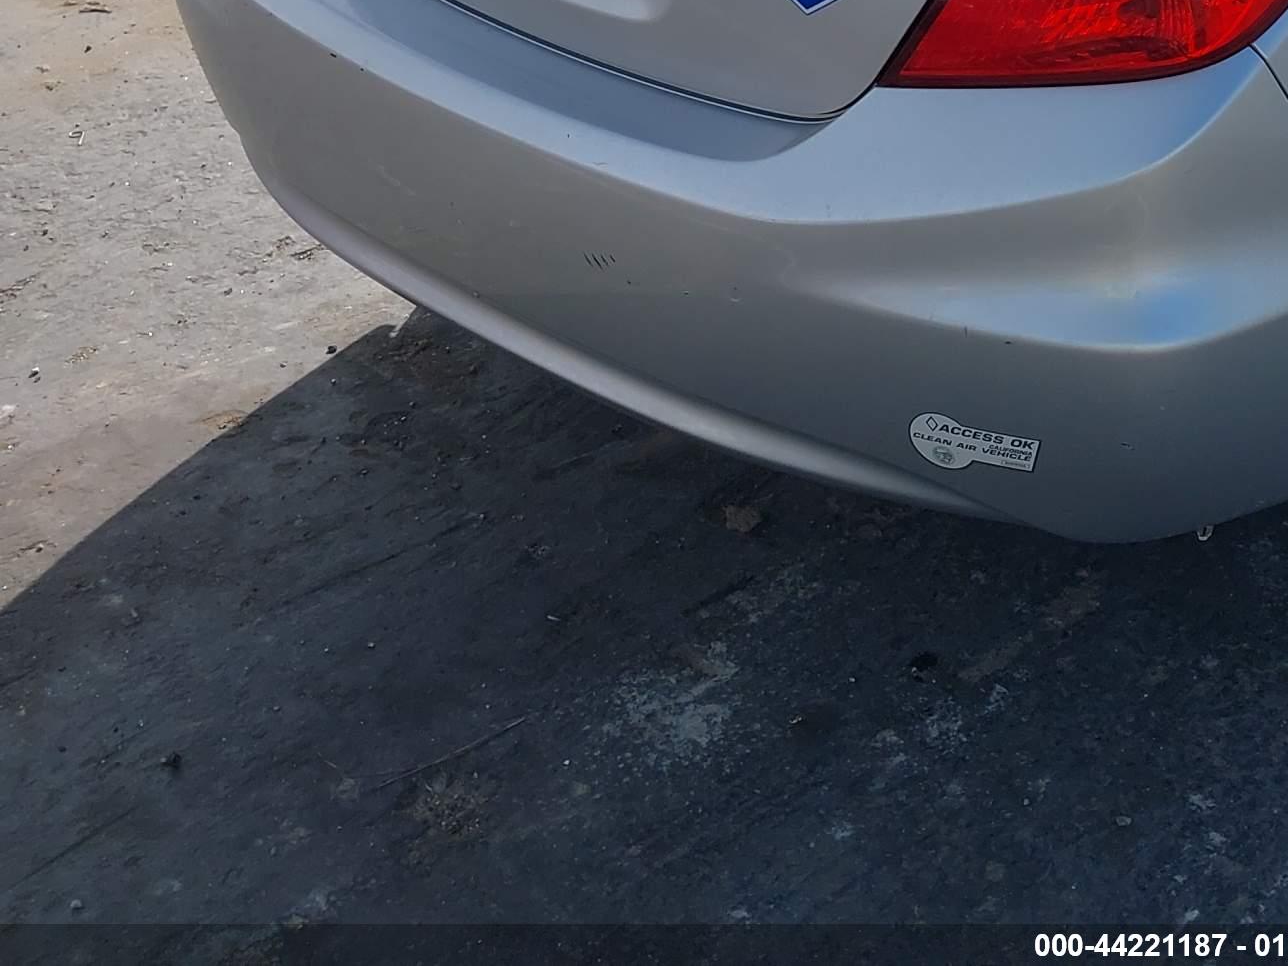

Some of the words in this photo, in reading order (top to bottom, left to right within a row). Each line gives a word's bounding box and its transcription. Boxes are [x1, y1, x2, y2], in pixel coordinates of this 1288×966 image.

[912, 432, 953, 446] CLEAN
[956, 442, 977, 452] AIR
[982, 447, 1032, 462] VEHICLE
[939, 423, 1005, 445] ACCESS
[1010, 438, 1035, 450] OK
